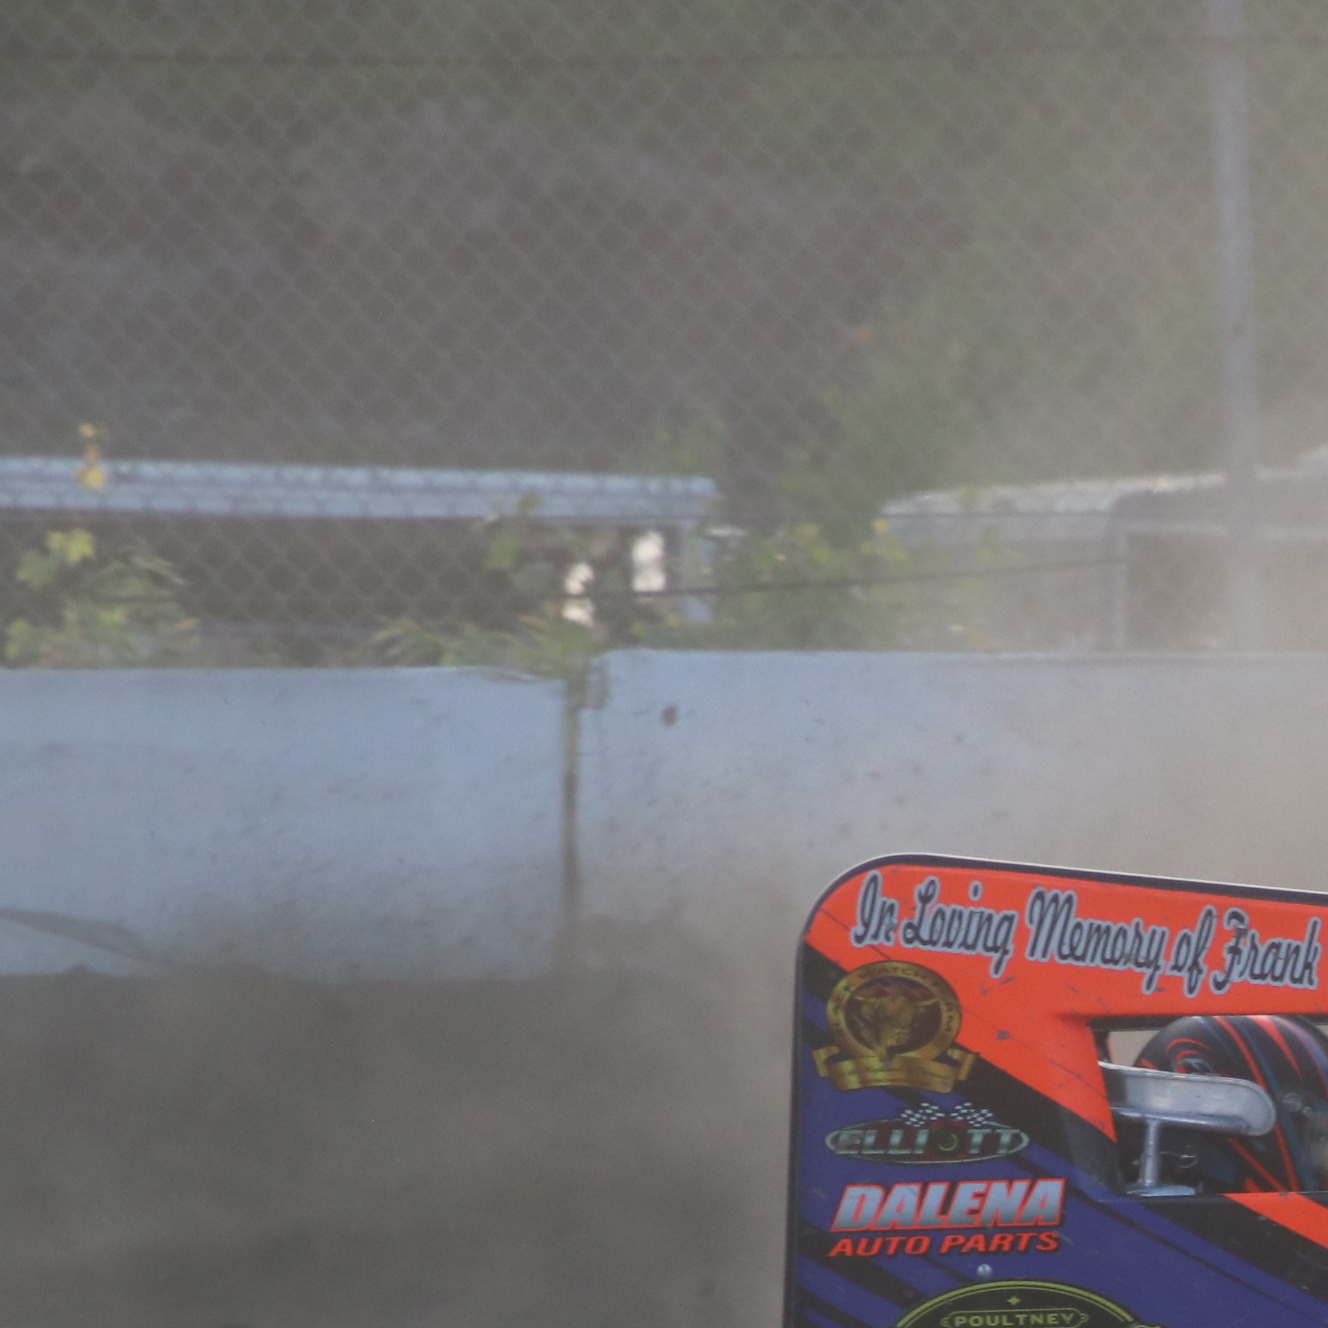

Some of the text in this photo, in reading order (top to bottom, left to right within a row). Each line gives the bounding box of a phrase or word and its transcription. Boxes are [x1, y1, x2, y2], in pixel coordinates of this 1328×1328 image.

[853, 871, 899, 948] In
[899, 876, 1018, 978] Loving
[1025, 887, 1168, 994] Memory
[1168, 905, 1217, 998] of
[1210, 907, 1321, 992] Frank
[830, 1177, 1067, 1233] DALENA
[828, 1231, 1061, 1257] AUTO PARTS
[954, 1312, 1076, 1328] POULTNEY
